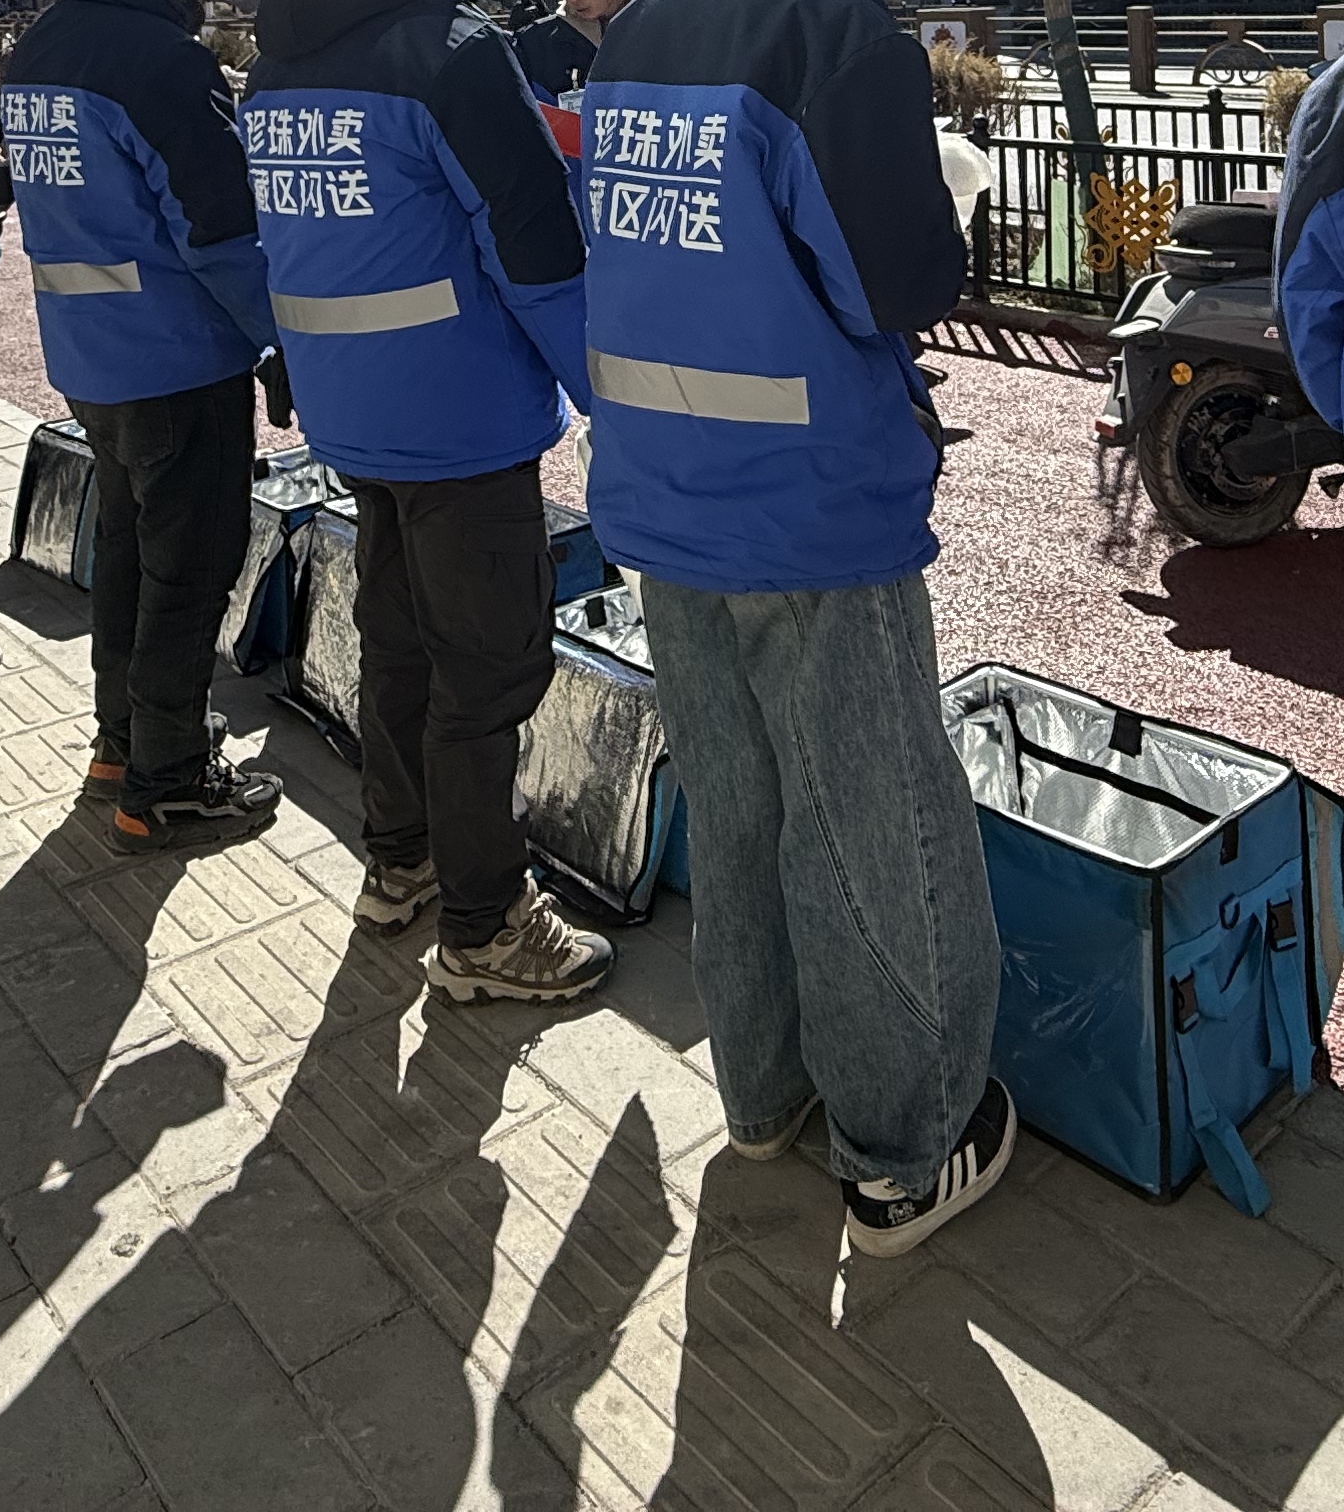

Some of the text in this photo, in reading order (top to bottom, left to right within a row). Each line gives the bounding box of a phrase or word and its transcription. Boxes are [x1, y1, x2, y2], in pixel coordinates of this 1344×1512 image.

[244, 108, 365, 156] 珍珠外卖
[594, 109, 728, 172] 珍珠外卖
